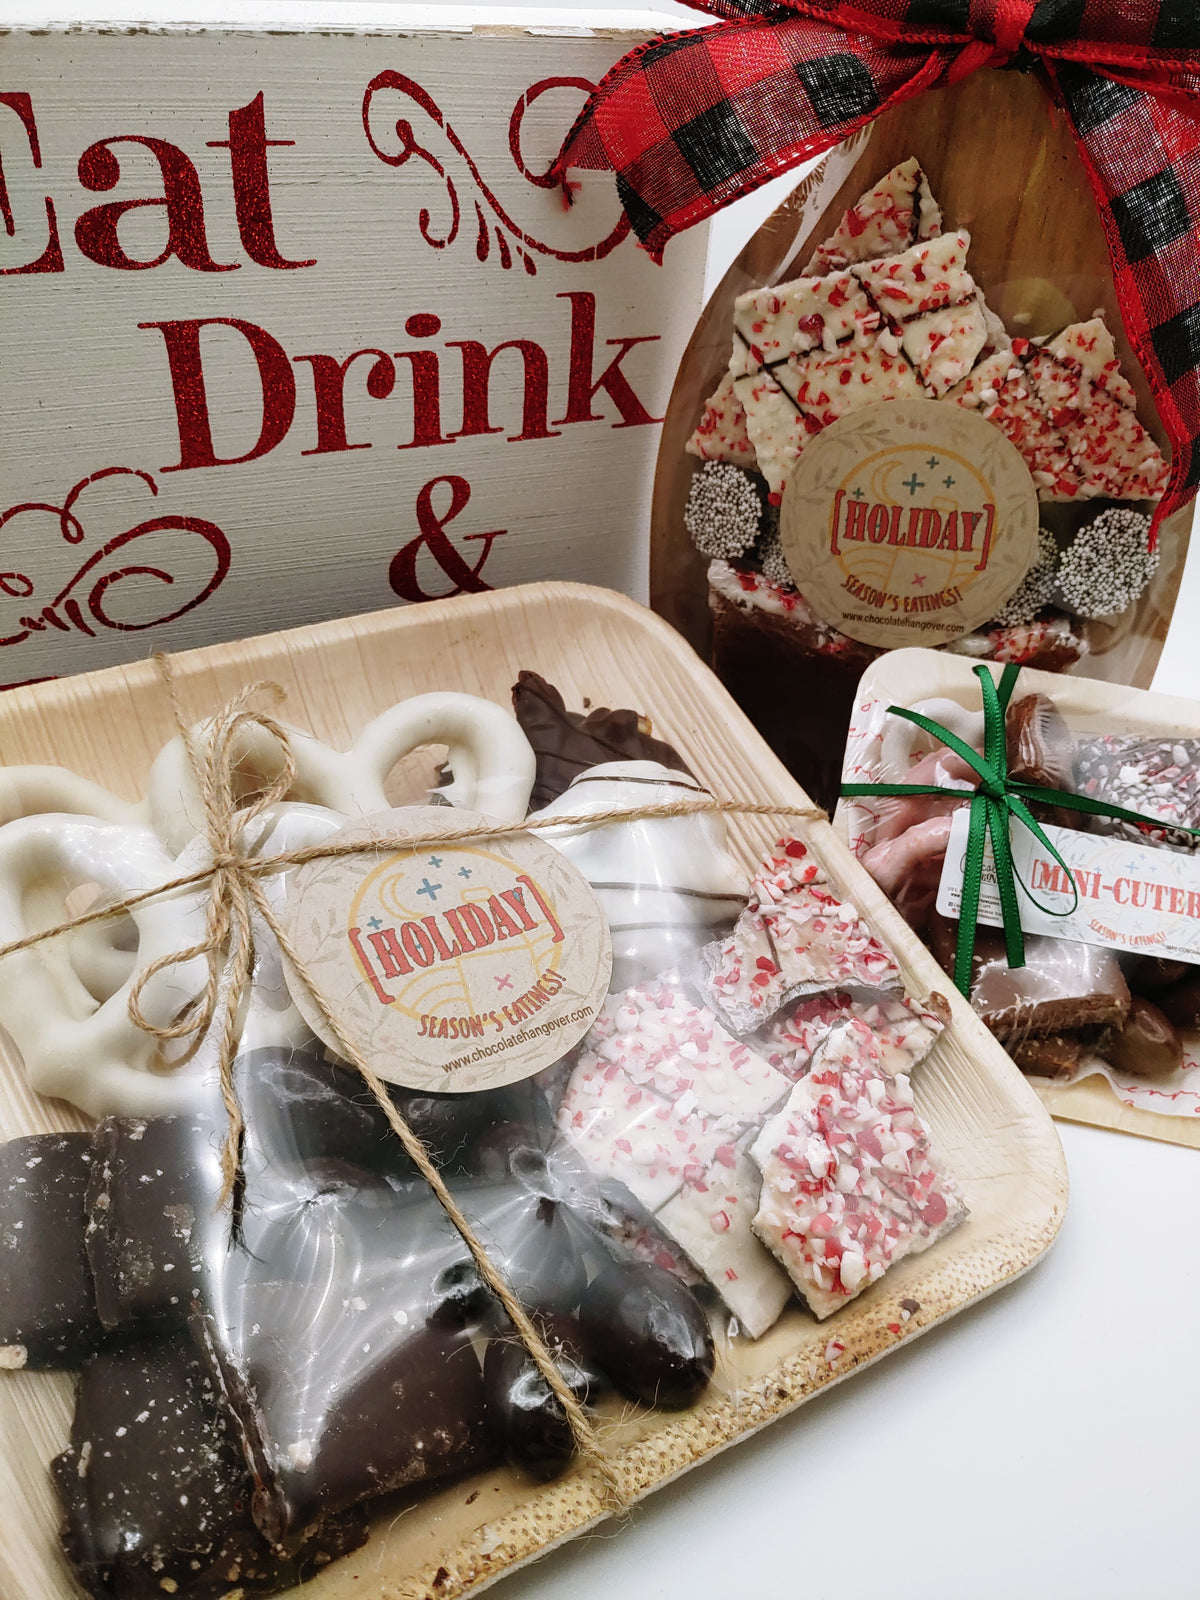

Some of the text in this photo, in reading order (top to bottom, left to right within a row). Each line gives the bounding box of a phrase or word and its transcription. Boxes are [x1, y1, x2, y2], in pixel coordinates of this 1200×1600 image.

[138, 292, 663, 472] Drink
[389, 475, 507, 602] &
[841, 574, 963, 613] SEASON'S EATINGS!
[842, 611, 965, 633] www.chocolatehangover.com
[417, 968, 567, 1040] SEASON'S EATINGS!
[441, 1005, 594, 1074] www.chocolatehangover.com
